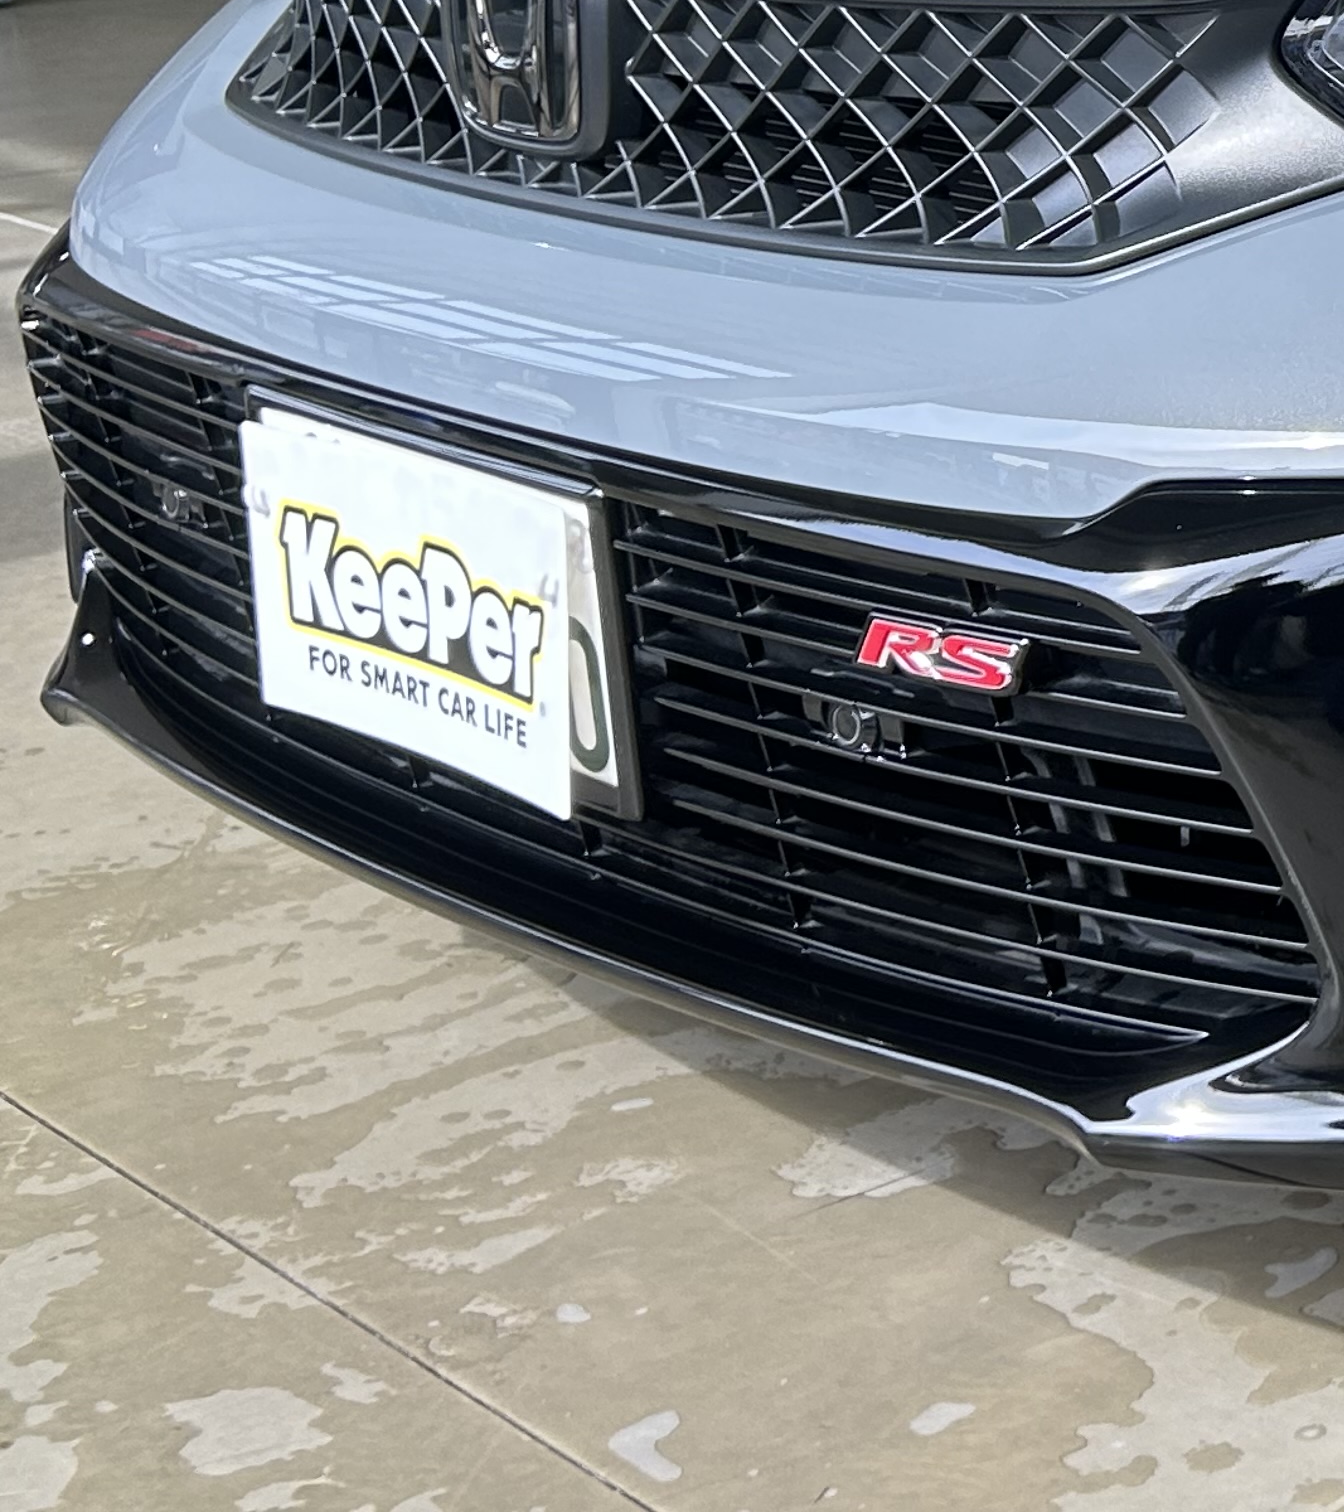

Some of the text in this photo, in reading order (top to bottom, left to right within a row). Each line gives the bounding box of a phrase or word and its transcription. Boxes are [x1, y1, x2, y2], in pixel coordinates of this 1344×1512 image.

[279, 505, 545, 703] KeePer
[857, 614, 1023, 692] RS
[308, 644, 528, 749] FOR SMART CAR LIFE
